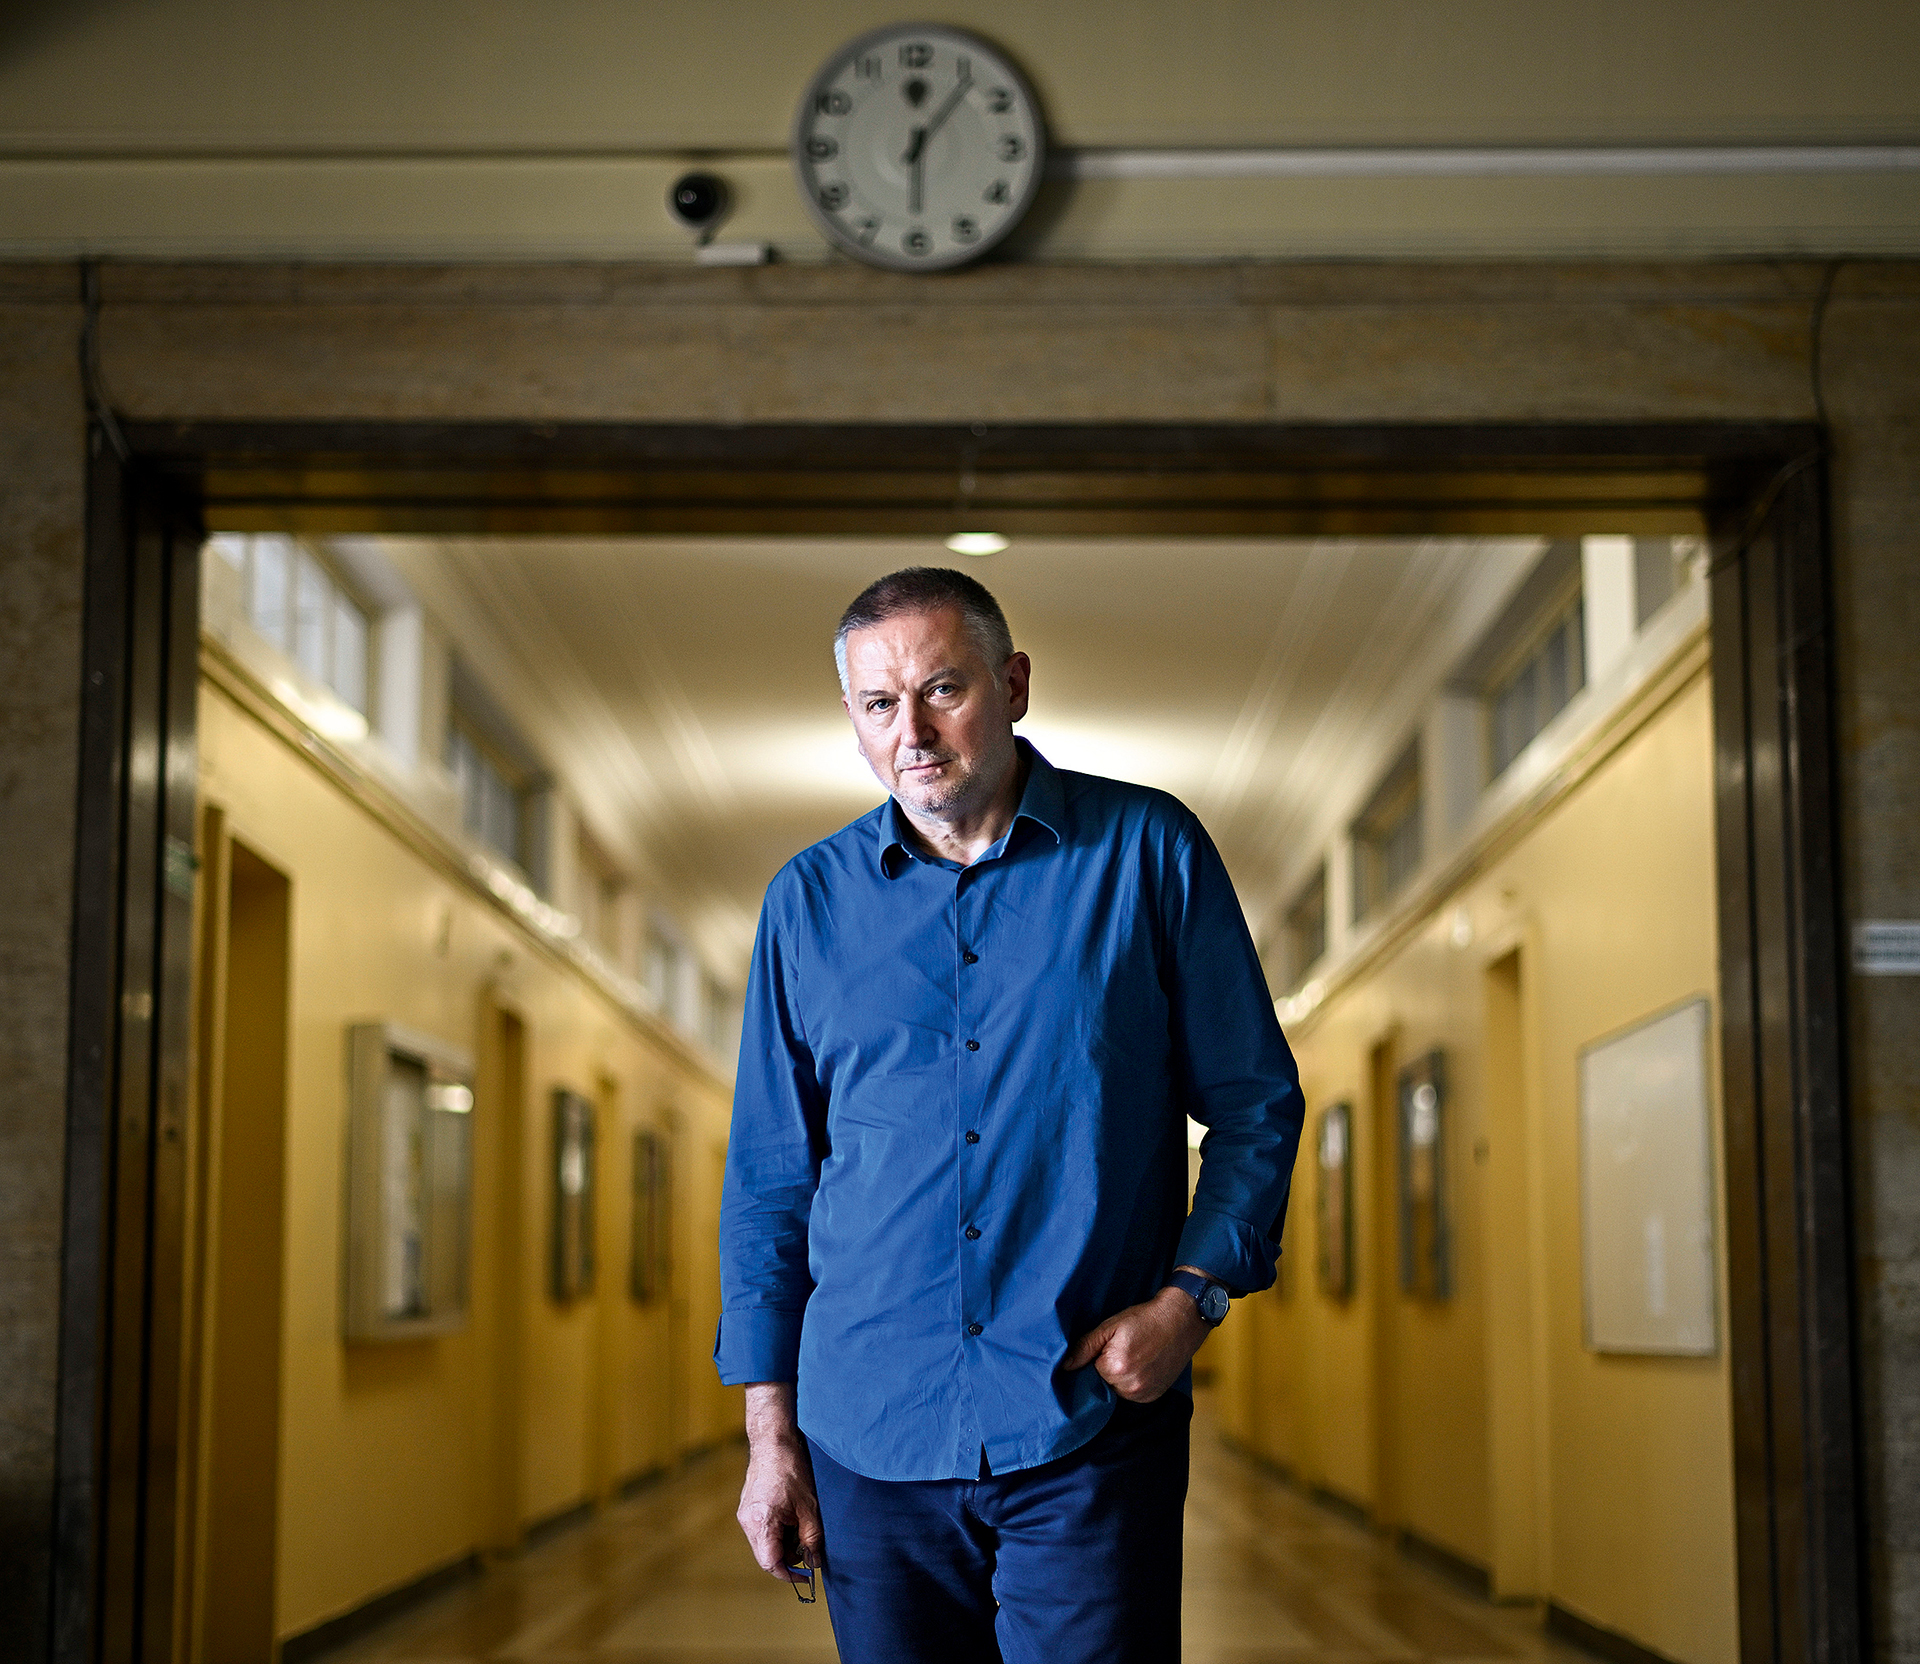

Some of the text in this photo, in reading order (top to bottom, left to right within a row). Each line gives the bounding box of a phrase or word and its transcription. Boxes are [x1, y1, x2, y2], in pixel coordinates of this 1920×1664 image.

[855, 54, 882, 79] 11
[900, 42, 933, 68] 12
[816, 89, 852, 116] 10
[987, 86, 1014, 114] 2
[807, 134, 839, 163] 9
[1000, 133, 1027, 163] 3
[820, 181, 849, 211] 8
[983, 178, 1011, 205] 4
[856, 214, 883, 246] 7
[901, 227, 934, 257] 6
[952, 213, 982, 244] 5
